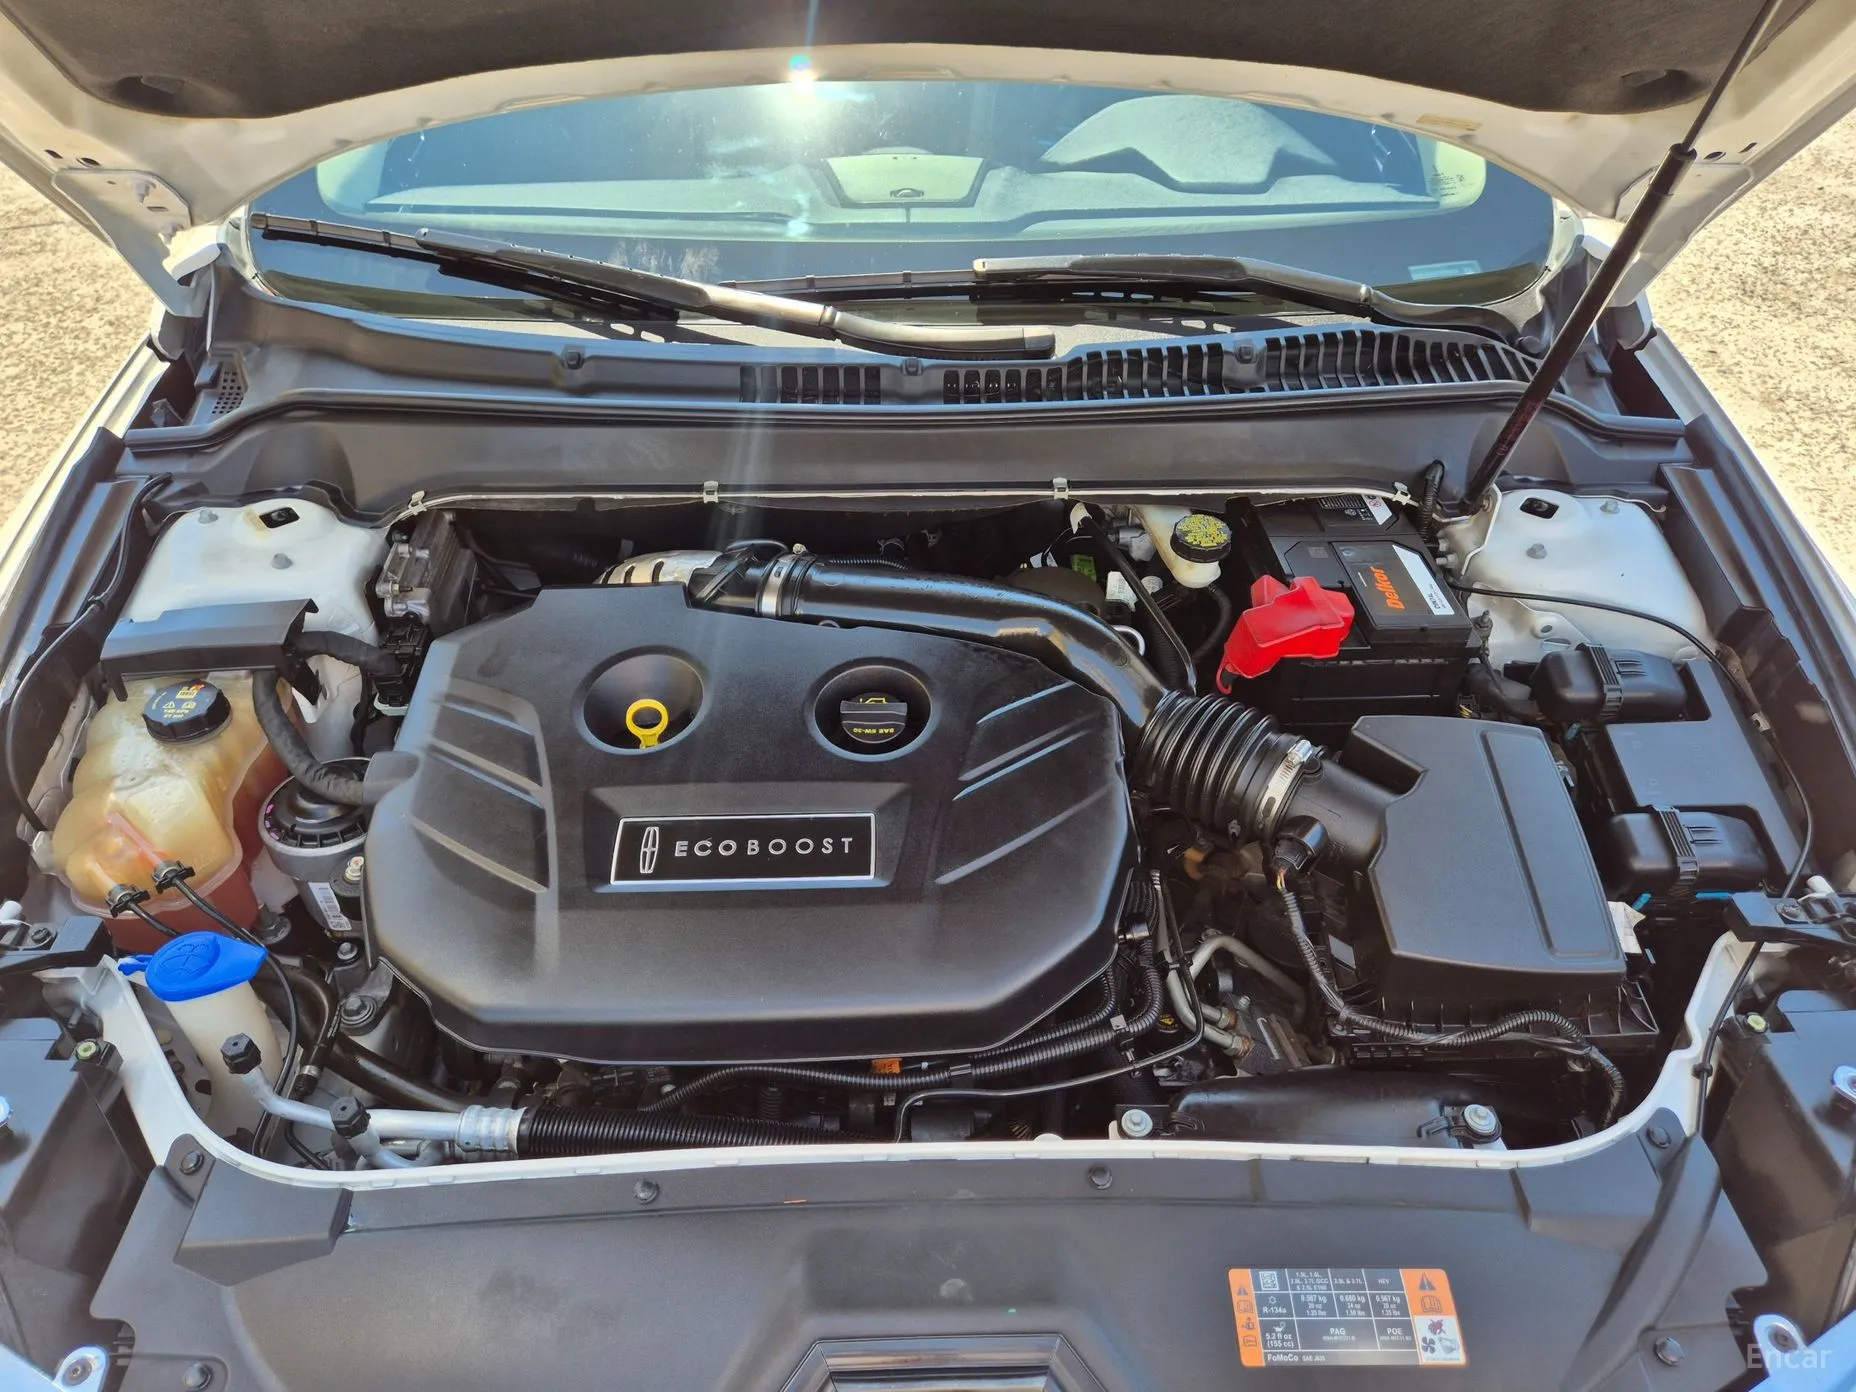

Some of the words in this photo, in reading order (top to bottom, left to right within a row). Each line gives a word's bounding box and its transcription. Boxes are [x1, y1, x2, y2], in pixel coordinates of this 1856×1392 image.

[1370, 566, 1406, 610] Delkor
[674, 837, 853, 857] ECOBOOST
[1318, 1295, 1327, 1303] kg
[1356, 1295, 1365, 1304] kg
[1392, 1295, 1401, 1304] kg
[1262, 1306, 1287, 1315] R-134a
[1265, 1332, 1277, 1340] 5.2
[1267, 1340, 1283, 1348] (155
[1283, 1340, 1294, 1348] cc)
[1267, 1354, 1299, 1362] FoMoCo
